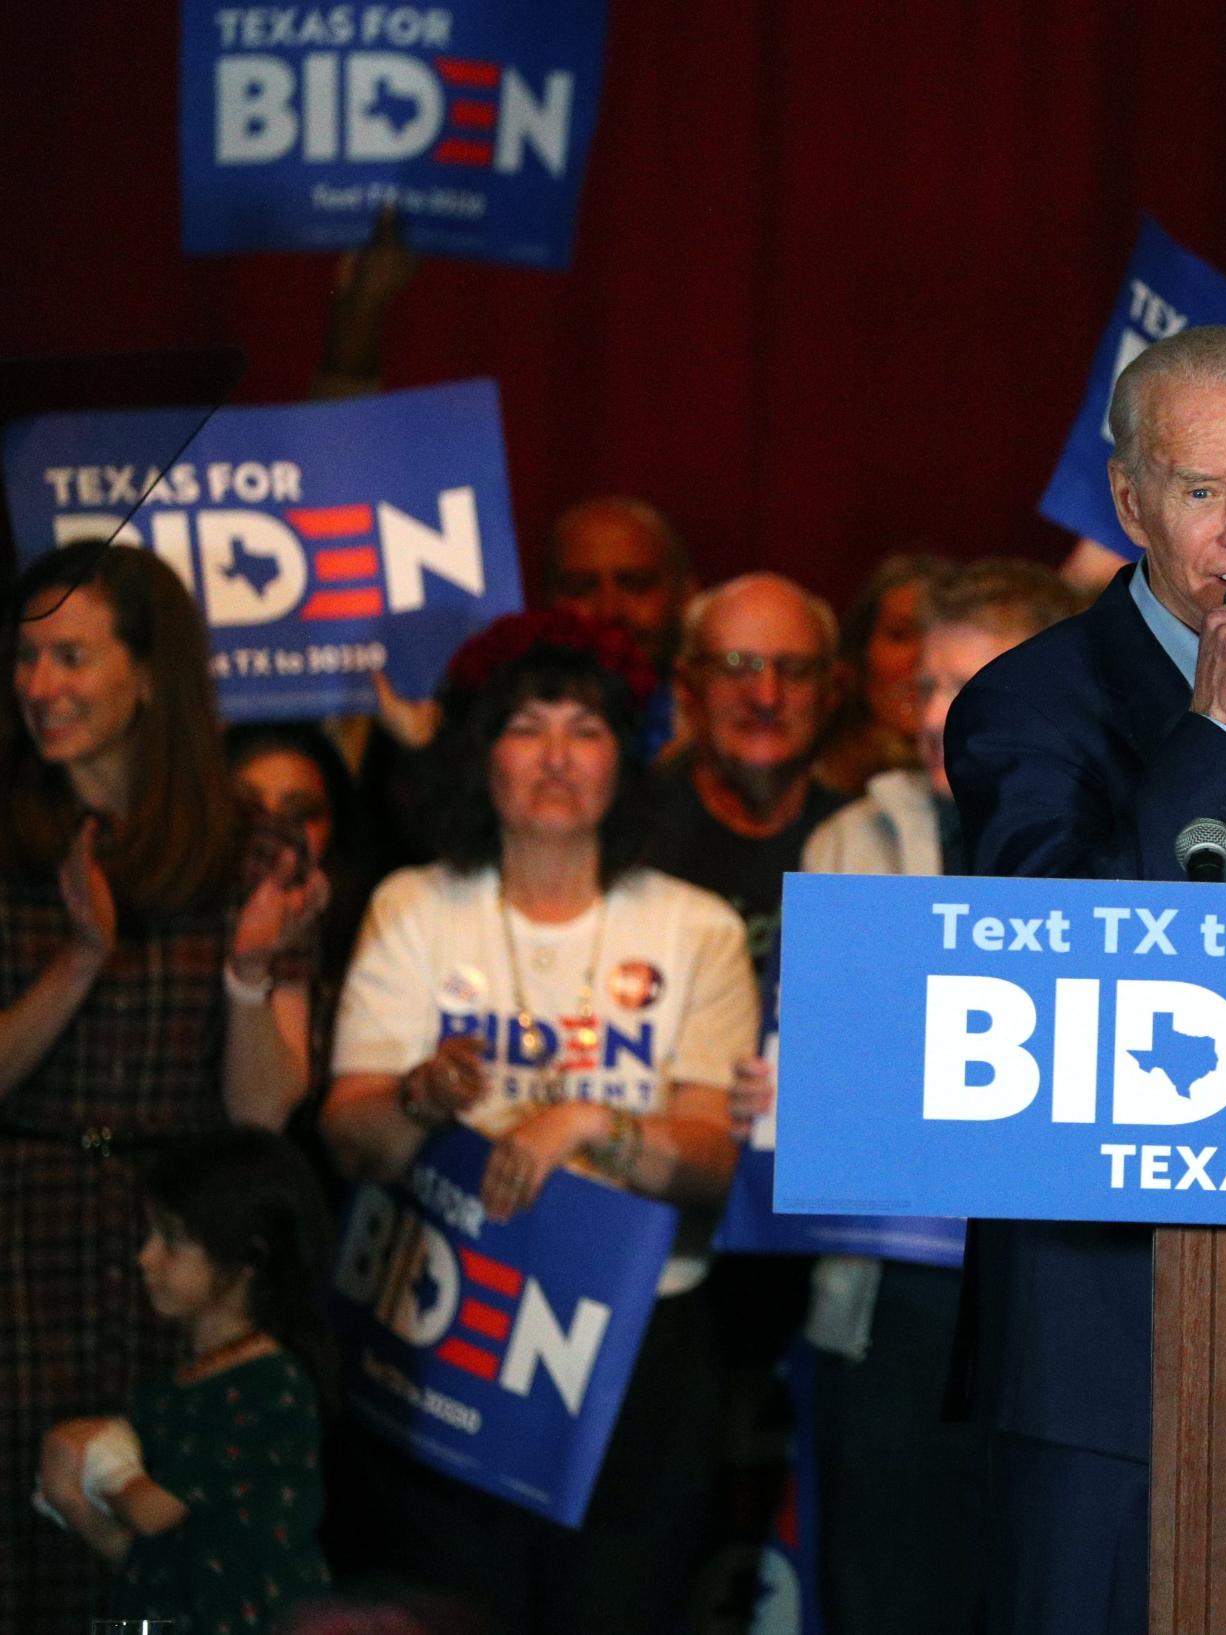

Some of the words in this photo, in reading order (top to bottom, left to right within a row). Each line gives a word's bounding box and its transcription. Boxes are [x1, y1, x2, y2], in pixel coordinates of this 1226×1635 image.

[215, 6, 354, 48] TEXAS
[362, 8, 453, 50] FOR
[213, 50, 574, 179] BIDEN
[1130, 278, 1189, 338] TEX
[45, 464, 199, 505] TEXAS
[206, 461, 302, 502] FOR
[932, 903, 1071, 952] Text
[1093, 906, 1179, 956] TX
